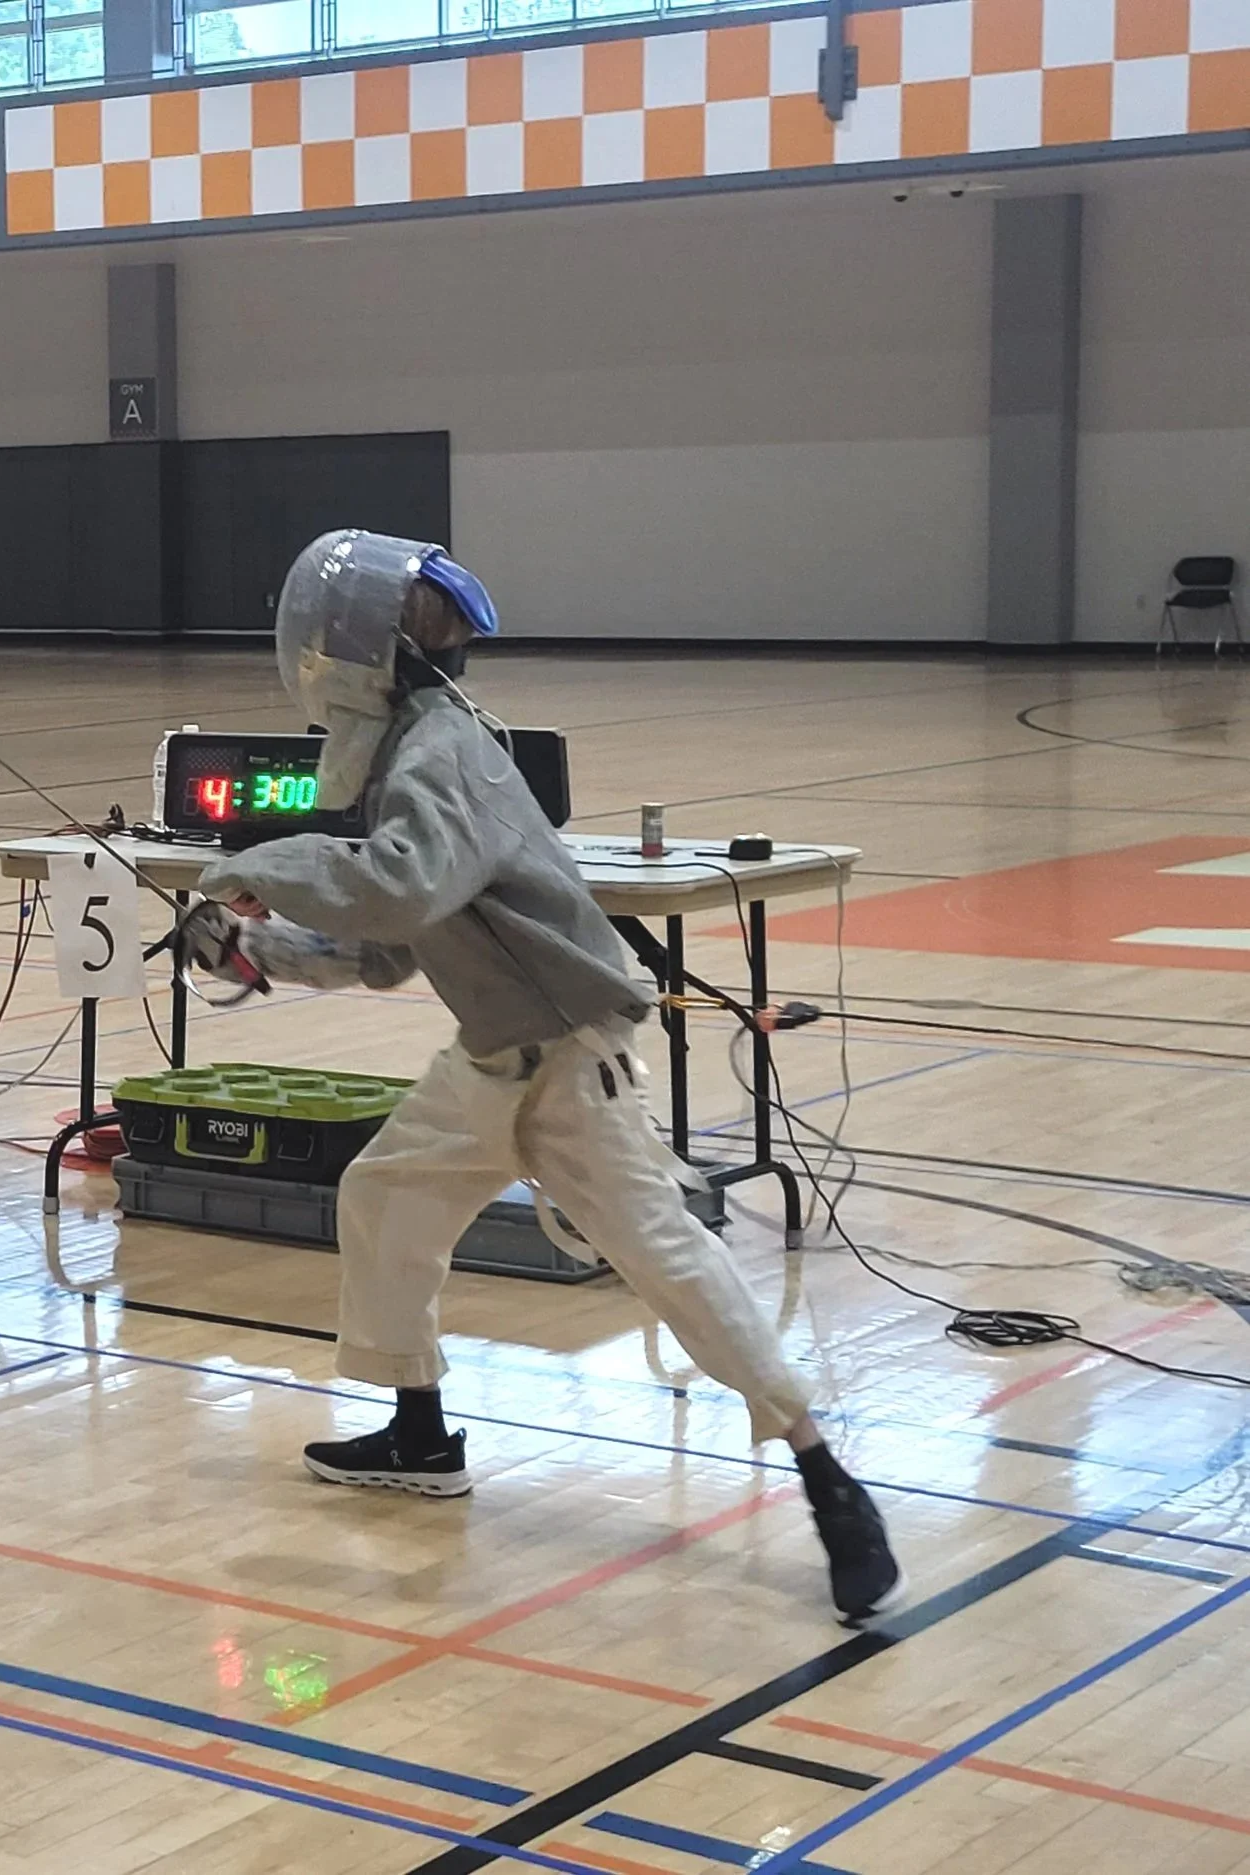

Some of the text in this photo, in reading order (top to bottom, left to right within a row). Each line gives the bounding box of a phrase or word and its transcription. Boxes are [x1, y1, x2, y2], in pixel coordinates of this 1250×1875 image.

[121, 384, 144, 395] GYM
[122, 399, 143, 424] A
[203, 774, 317, 819] 4 3:00
[80, 896, 114, 972] 5
[207, 1119, 249, 1137] RYOBI
